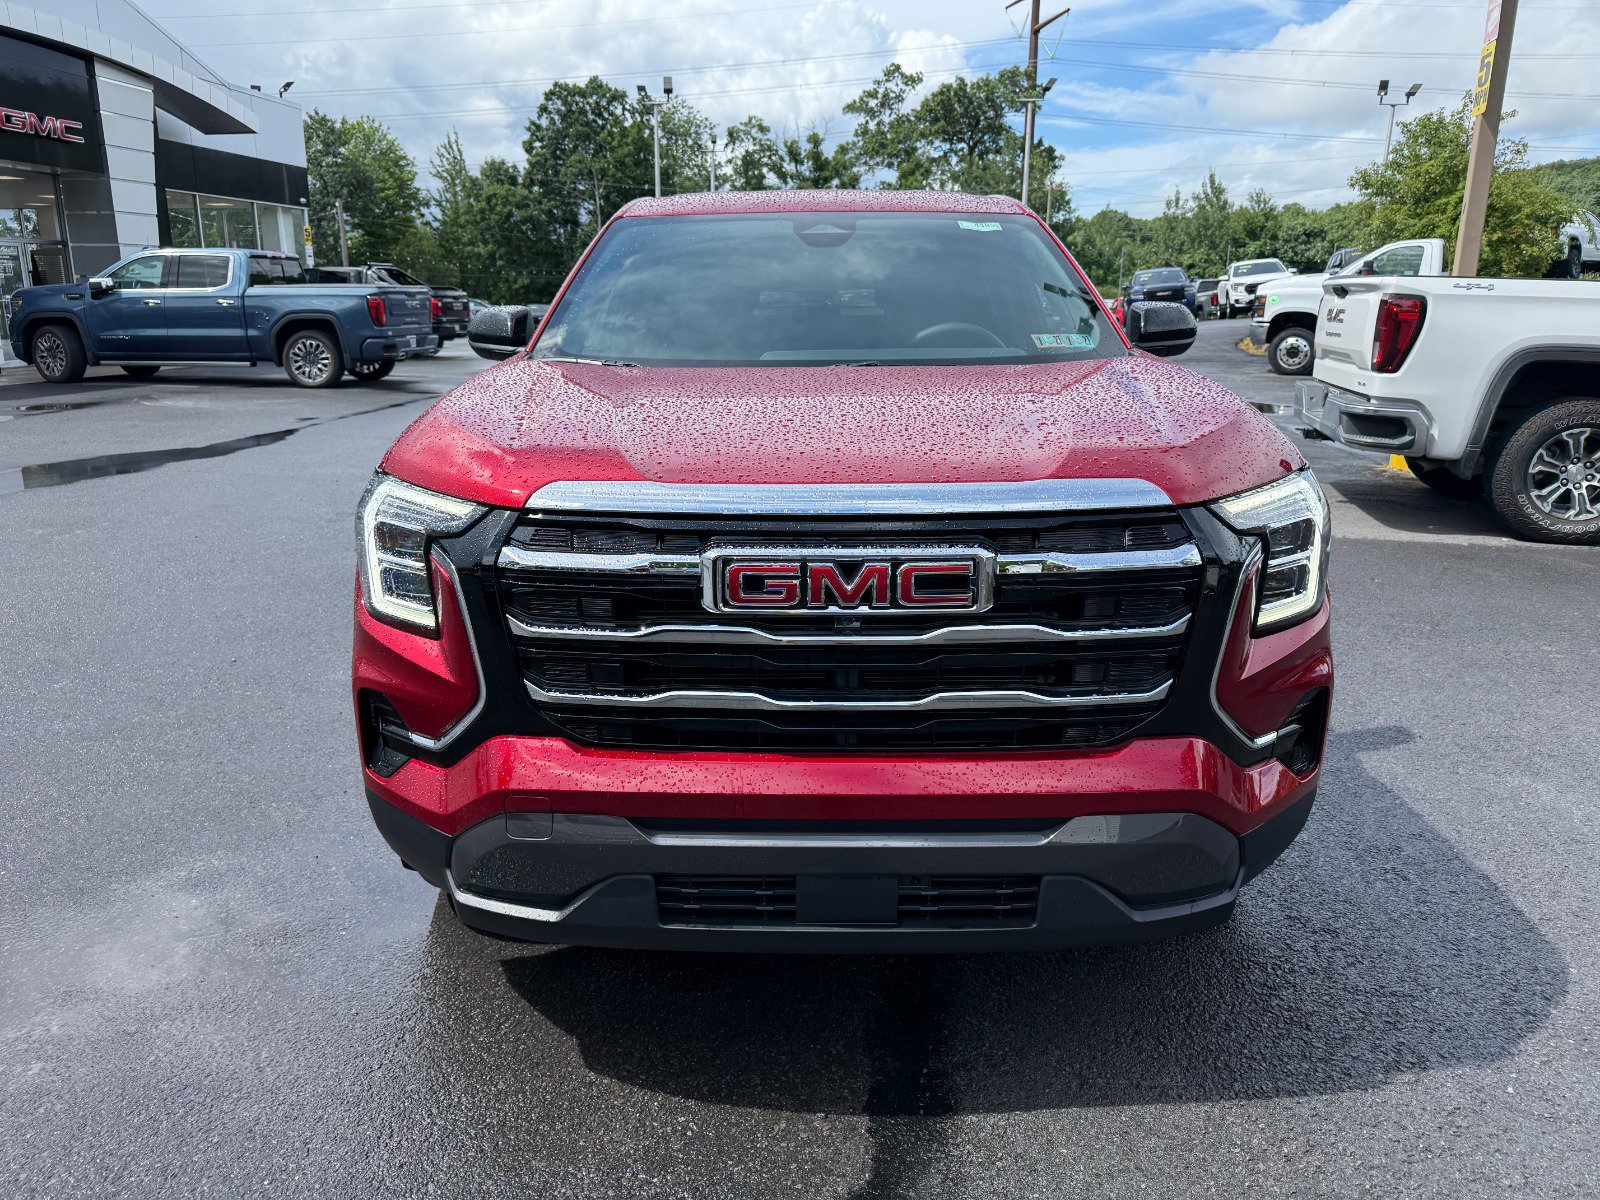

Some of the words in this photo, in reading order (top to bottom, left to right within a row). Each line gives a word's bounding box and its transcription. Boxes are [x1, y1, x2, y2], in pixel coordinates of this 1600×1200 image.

[1478, 51, 1493, 88] 5
[0, 107, 85, 144] GMC
[726, 562, 976, 608] GMC
